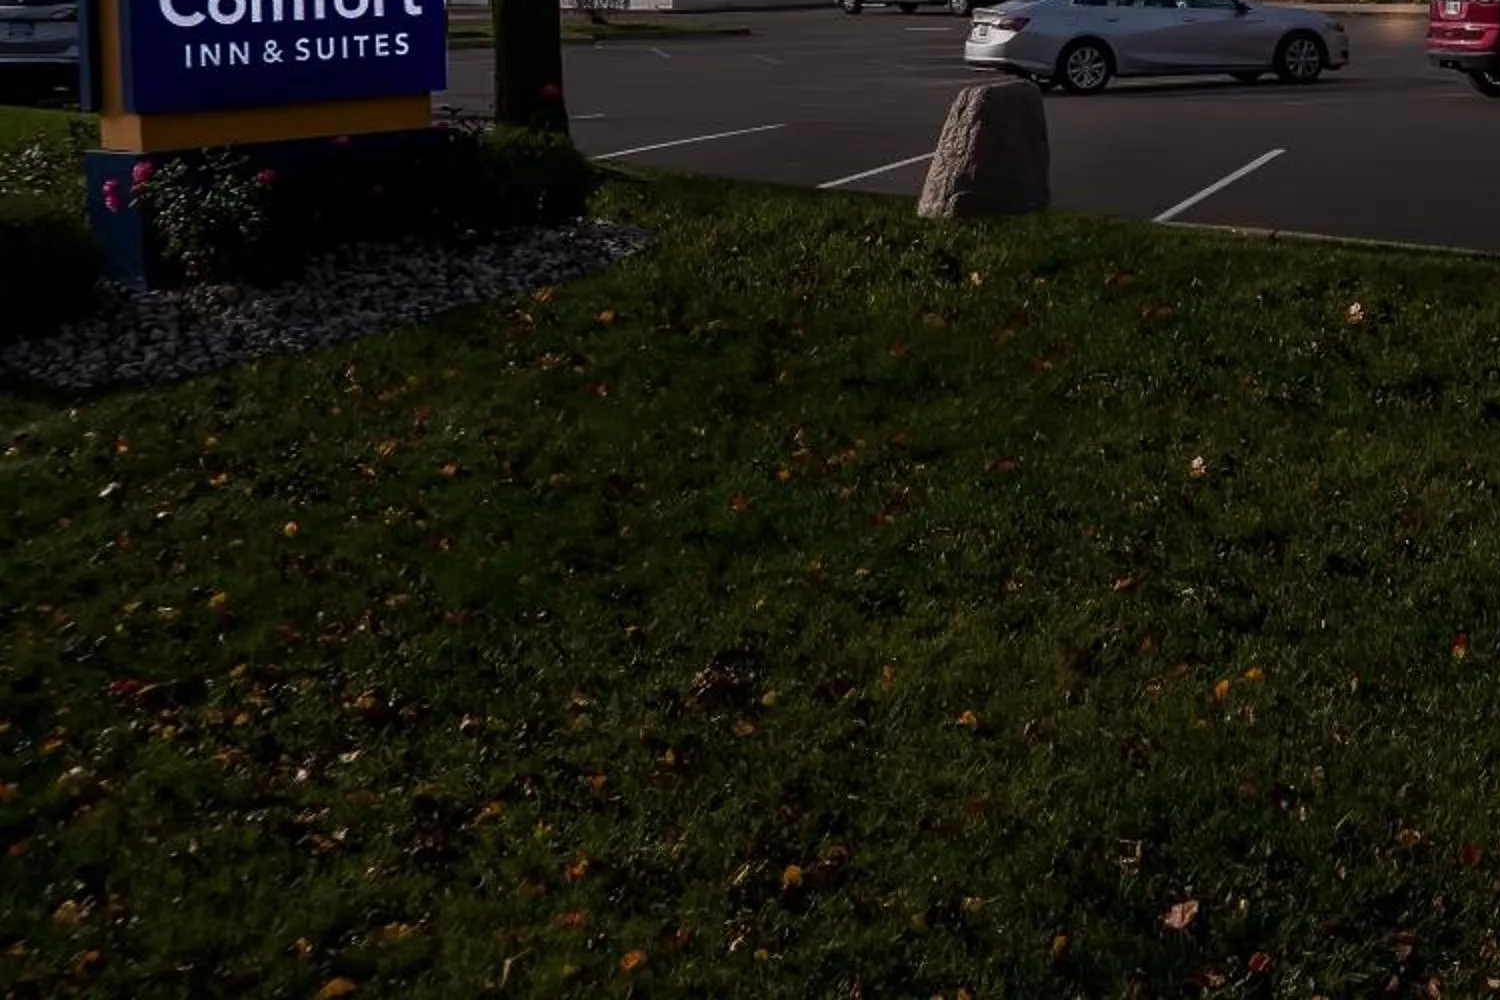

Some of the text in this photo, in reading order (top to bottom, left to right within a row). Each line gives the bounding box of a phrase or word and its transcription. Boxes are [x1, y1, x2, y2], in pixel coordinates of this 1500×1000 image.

[185, 33, 410, 69] INN & SUITES
